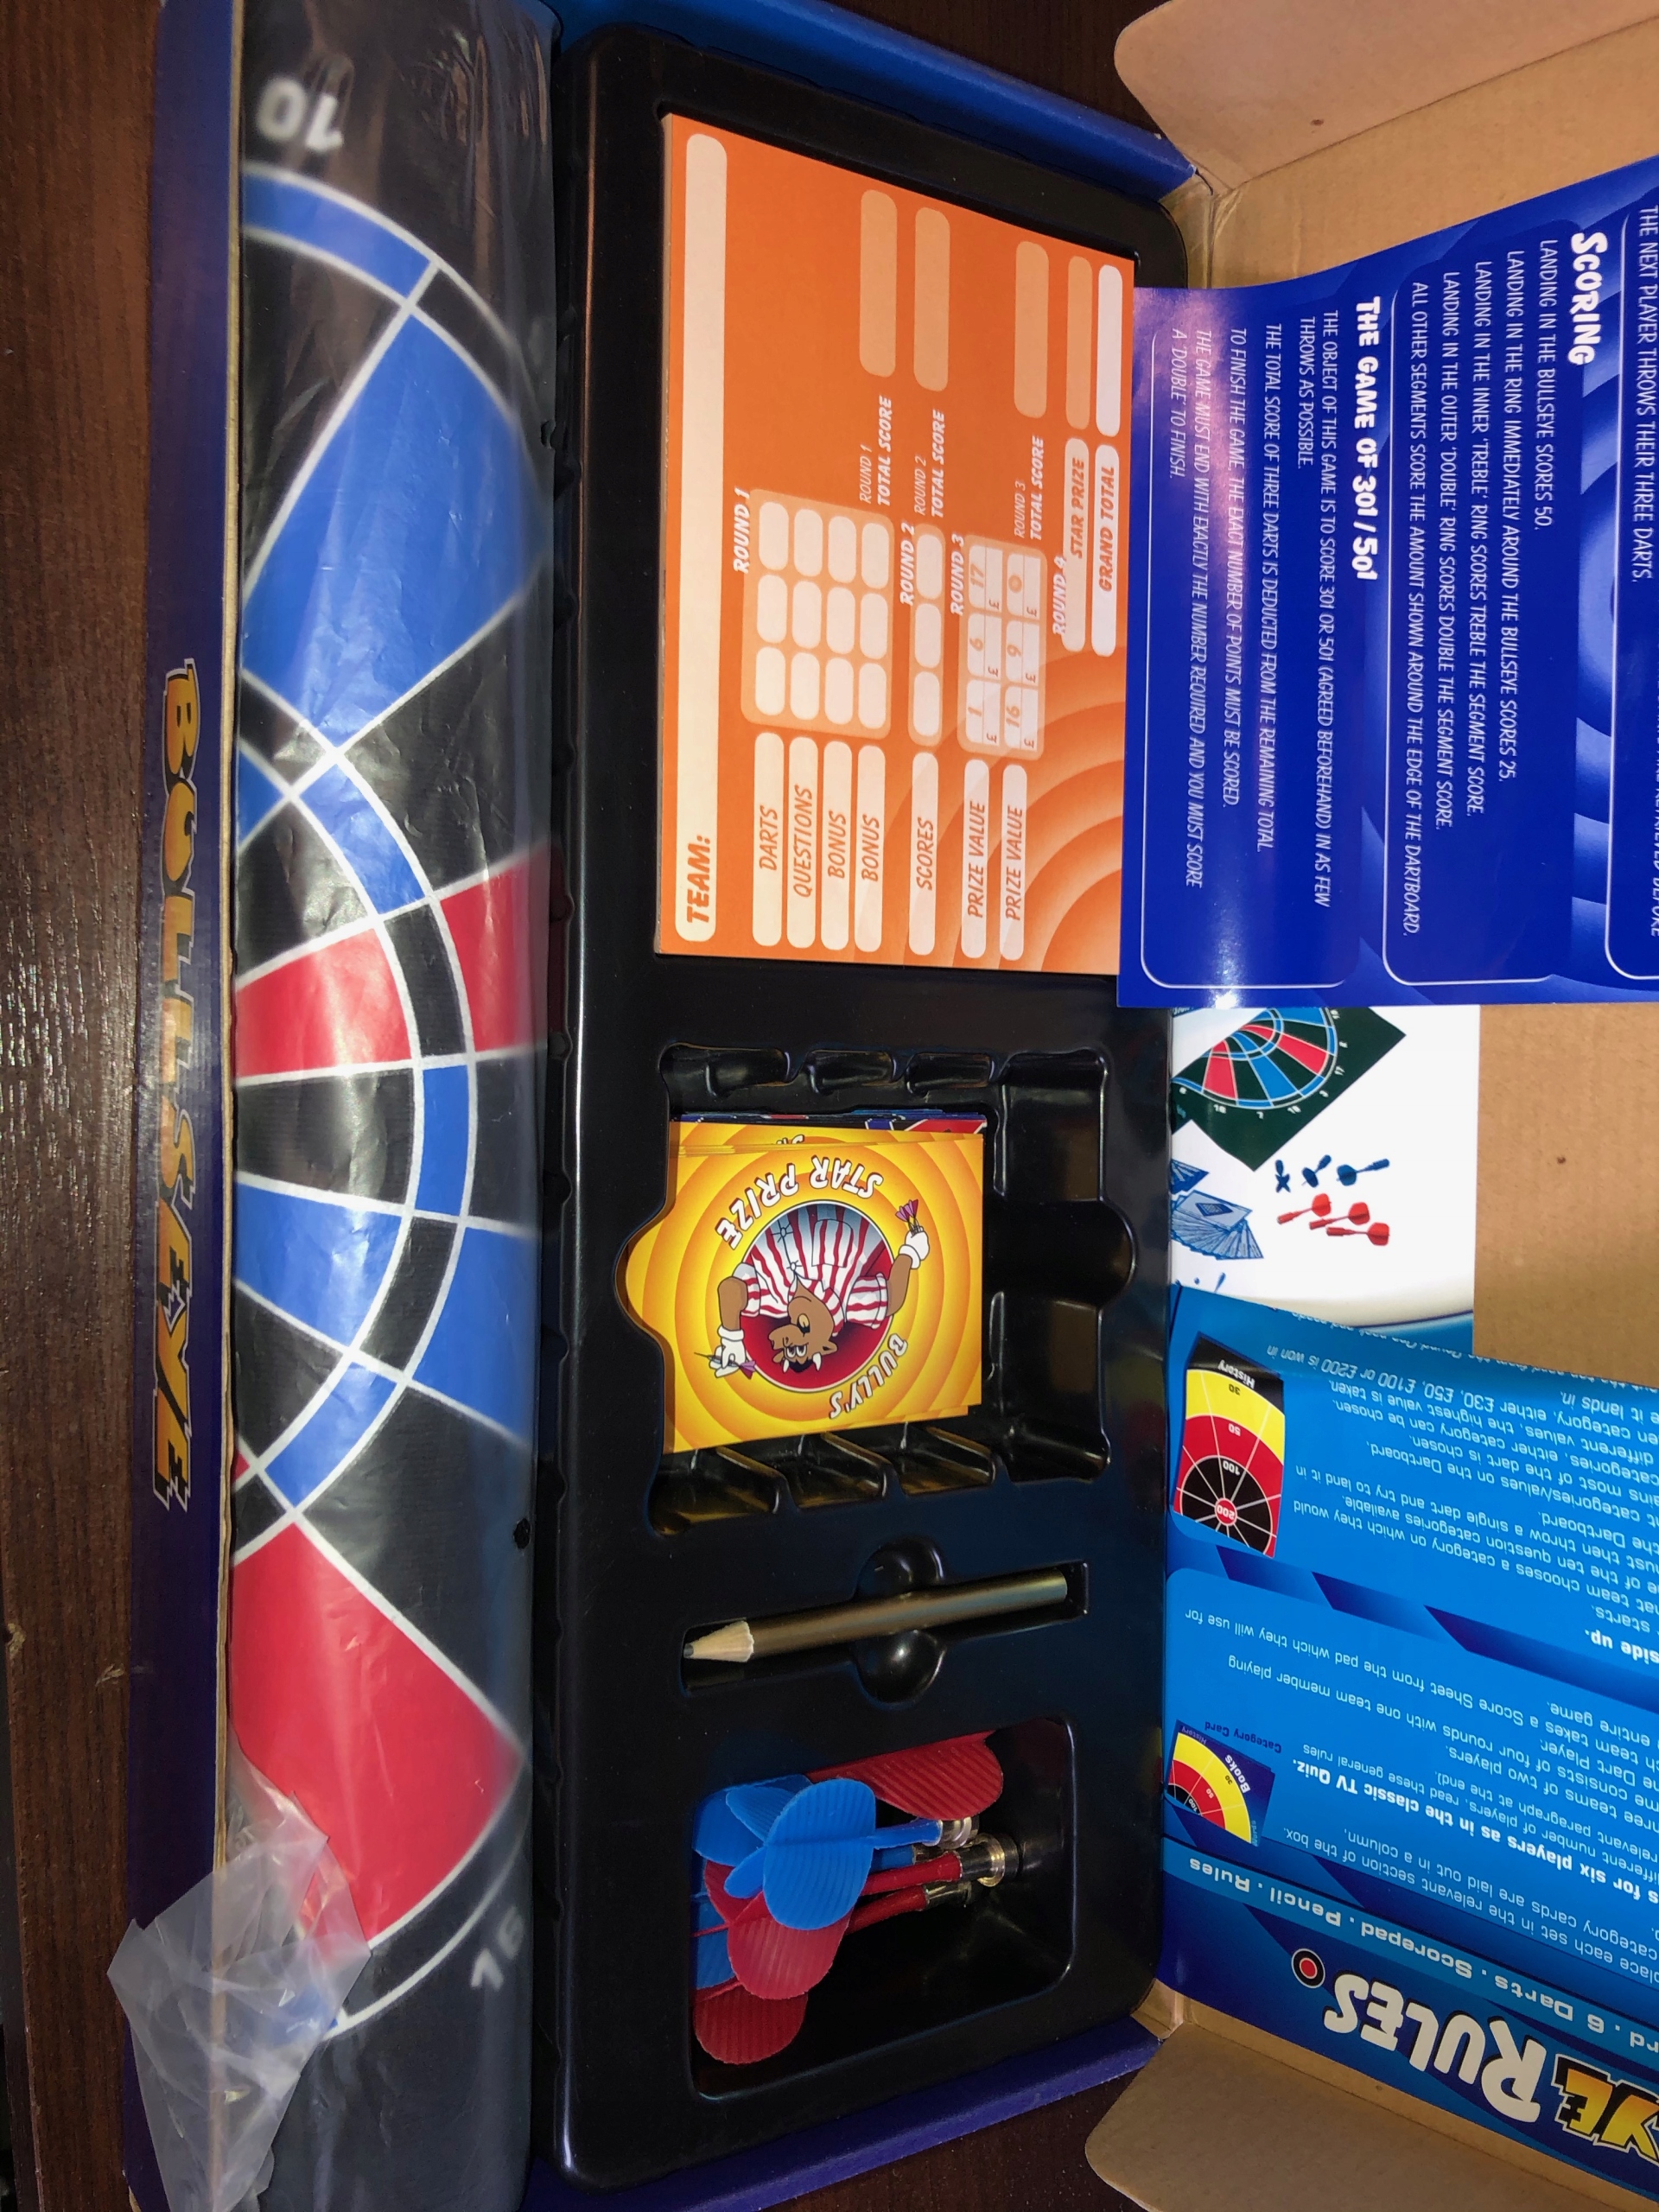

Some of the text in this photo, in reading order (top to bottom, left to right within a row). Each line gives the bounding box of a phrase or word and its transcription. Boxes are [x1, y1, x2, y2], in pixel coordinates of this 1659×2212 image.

[254, 76, 346, 154] 10
[1172, 329, 1187, 339] A
[1357, 296, 1380, 346] THE
[1298, 316, 1314, 469] THROWS AS POSSIBLE.
[1355, 357, 1378, 429] GAME
[1534, 239, 1557, 530] LANDING IN THE BULLSEYE SCORES 50.
[1631, 207, 1658, 582] THE NEXT PLAYER THROWS THEIR THREE DARTS.
[877, 396, 892, 505] TOTAL SCORE
[1171, 410, 1185, 427] TO
[859, 455, 871, 504] ROUND
[915, 456, 926, 515] ROUND 2
[931, 410, 945, 518] TOTAL SCORE
[1170, 430, 1185, 479] FINISH.
[1357, 438, 1377, 468] OF
[1014, 481, 1025, 538] ROUND 3
[1031, 435, 1044, 540] TOTAL SCORE
[1071, 457, 1084, 559] STAR PRIZE
[1498, 251, 1524, 781] LANDING IN THE RING IMMEDIATELY AROUND THE BULLSEYE SCORES 25.
[734, 486, 750, 574] ROUND 1
[1099, 467, 1114, 592] GRAND TOTAL
[899, 522, 914, 606] ROUND 2
[950, 533, 963, 615] ROUND 3
[970, 563, 984, 589] 17
[1052, 556, 1066, 635] ROUND 4
[1314, 310, 1338, 907] THE OBJECT OF THIS GAME IS TO SCORE 301 OR 501 (AGREED BEFOREHAND) IN AS FEW
[969, 638, 983, 652] 6
[1007, 644, 1021, 657] 9
[969, 706, 982, 717] 1
[1006, 705, 1020, 728] 16
[759, 805, 779, 871] DARTS
[792, 785, 812, 899] QUESTIONS
[827, 810, 846, 880] BONUS
[861, 815, 880, 882] BONUS
[916, 817, 933, 891] SCORES
[968, 800, 985, 918] PRIZE VALUE
[1005, 805, 1023, 920] PRIZE VALUE
[687, 835, 710, 924] TEAM:
[153, 658, 200, 1515] BULLSEYE
[715, 1156, 883, 1249] STAR PRIZE
[829, 1333, 908, 1419] BULLY'S
[1217, 1359, 1255, 1389] History
[1267, 1345, 1278, 1356] in
[1281, 1350, 1305, 1363] won
[1308, 1356, 1319, 1370] is
[1322, 1358, 1357, 1376] £200
[1360, 1369, 1376, 1380] or
[1378, 1372, 1416, 1394] £100
[1229, 1384, 1240, 1395] 30
[1500, 1402, 1547, 1422] either
[1229, 1424, 1241, 1436] 50
[1223, 1460, 1240, 1476] 100
[1217, 1505, 1236, 1518] 200
[1294, 1500, 1629, 1611] team chooses a category on which they would
[1185, 1609, 1386, 1678] the pad which they will use for
[1585, 1629, 1612, 1650] up.
[1205, 1722, 1281, 1753] Category Card
[1189, 1798, 1198, 1812] 100
[1225, 1754, 1251, 1793] Books
[1225, 1775, 1232, 1785] 30
[1293, 1759, 1640, 1901] for six players as in the classic TV Quiz.
[1189, 1859, 1605, 2033] 6 Darts Scorepad Pencil Rules
